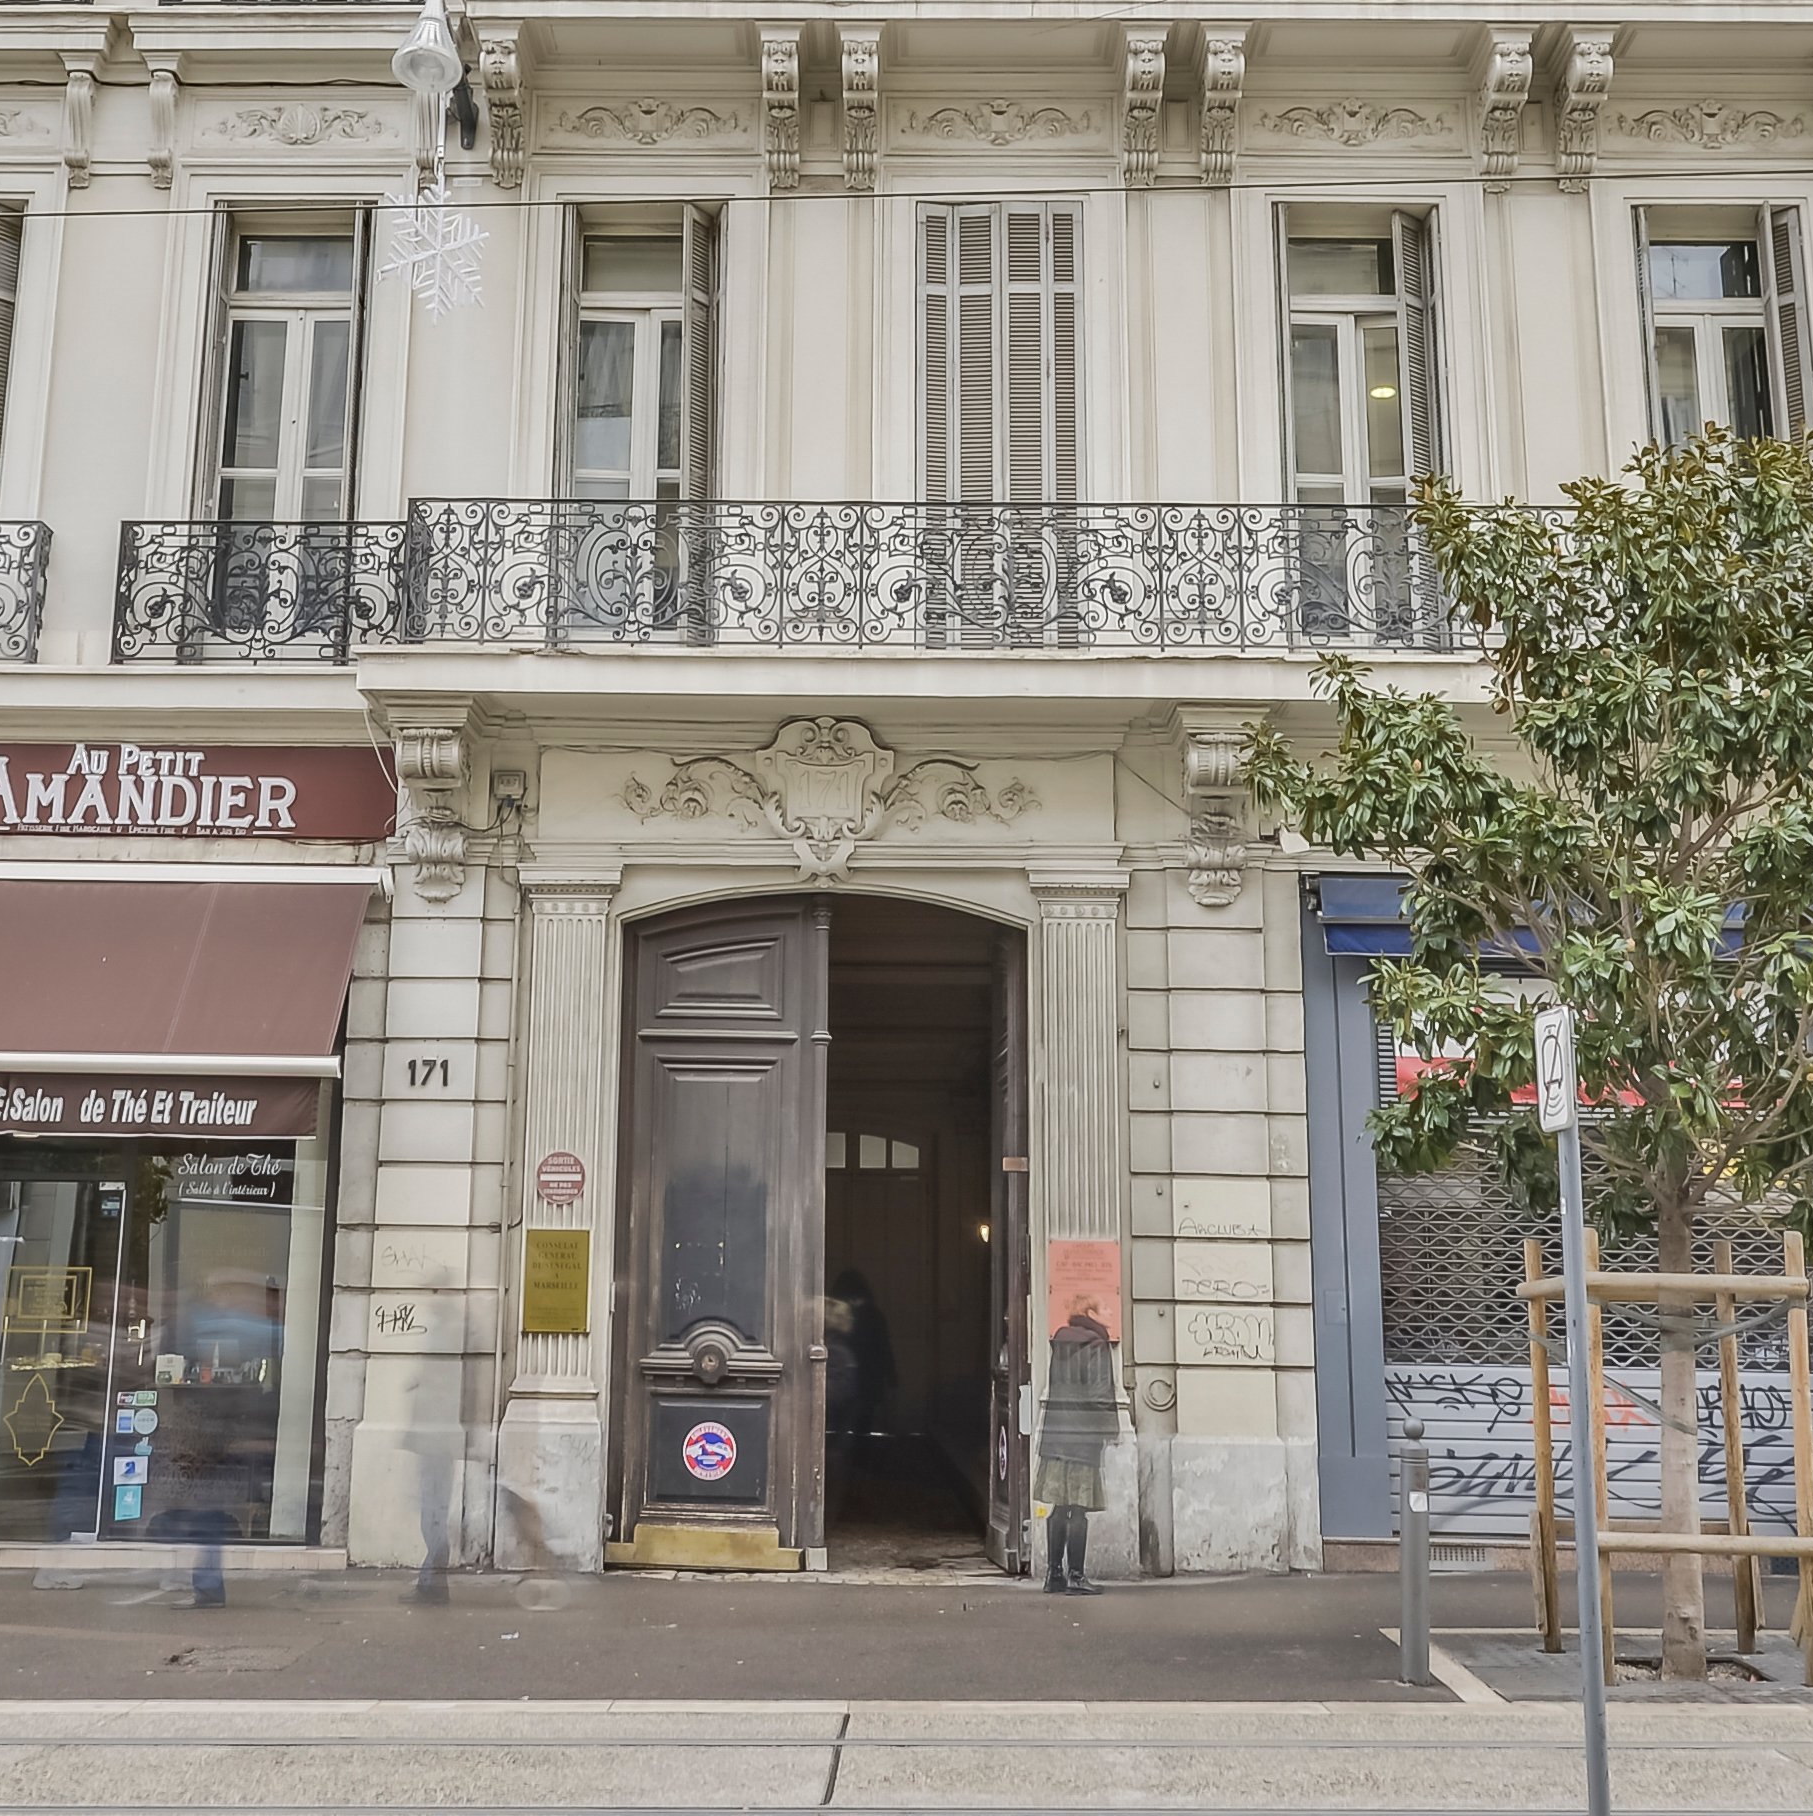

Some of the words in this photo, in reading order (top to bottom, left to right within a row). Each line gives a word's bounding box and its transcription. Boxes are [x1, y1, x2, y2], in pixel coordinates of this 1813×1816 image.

[66, 743, 110, 775] AU
[118, 743, 205, 777] PETIT
[408, 1059, 449, 1087] 171
[10, 1088, 64, 1122] Salon
[80, 1089, 106, 1123] de
[111, 1089, 147, 1123] Thé
[151, 1090, 174, 1124] Et
[179, 1091, 258, 1126] Traiteur
[178, 1153, 226, 1175] Salon
[228, 1155, 247, 1175] de
[247, 1153, 283, 1176] Thé
[548, 1156, 575, 1165] SORTIE
